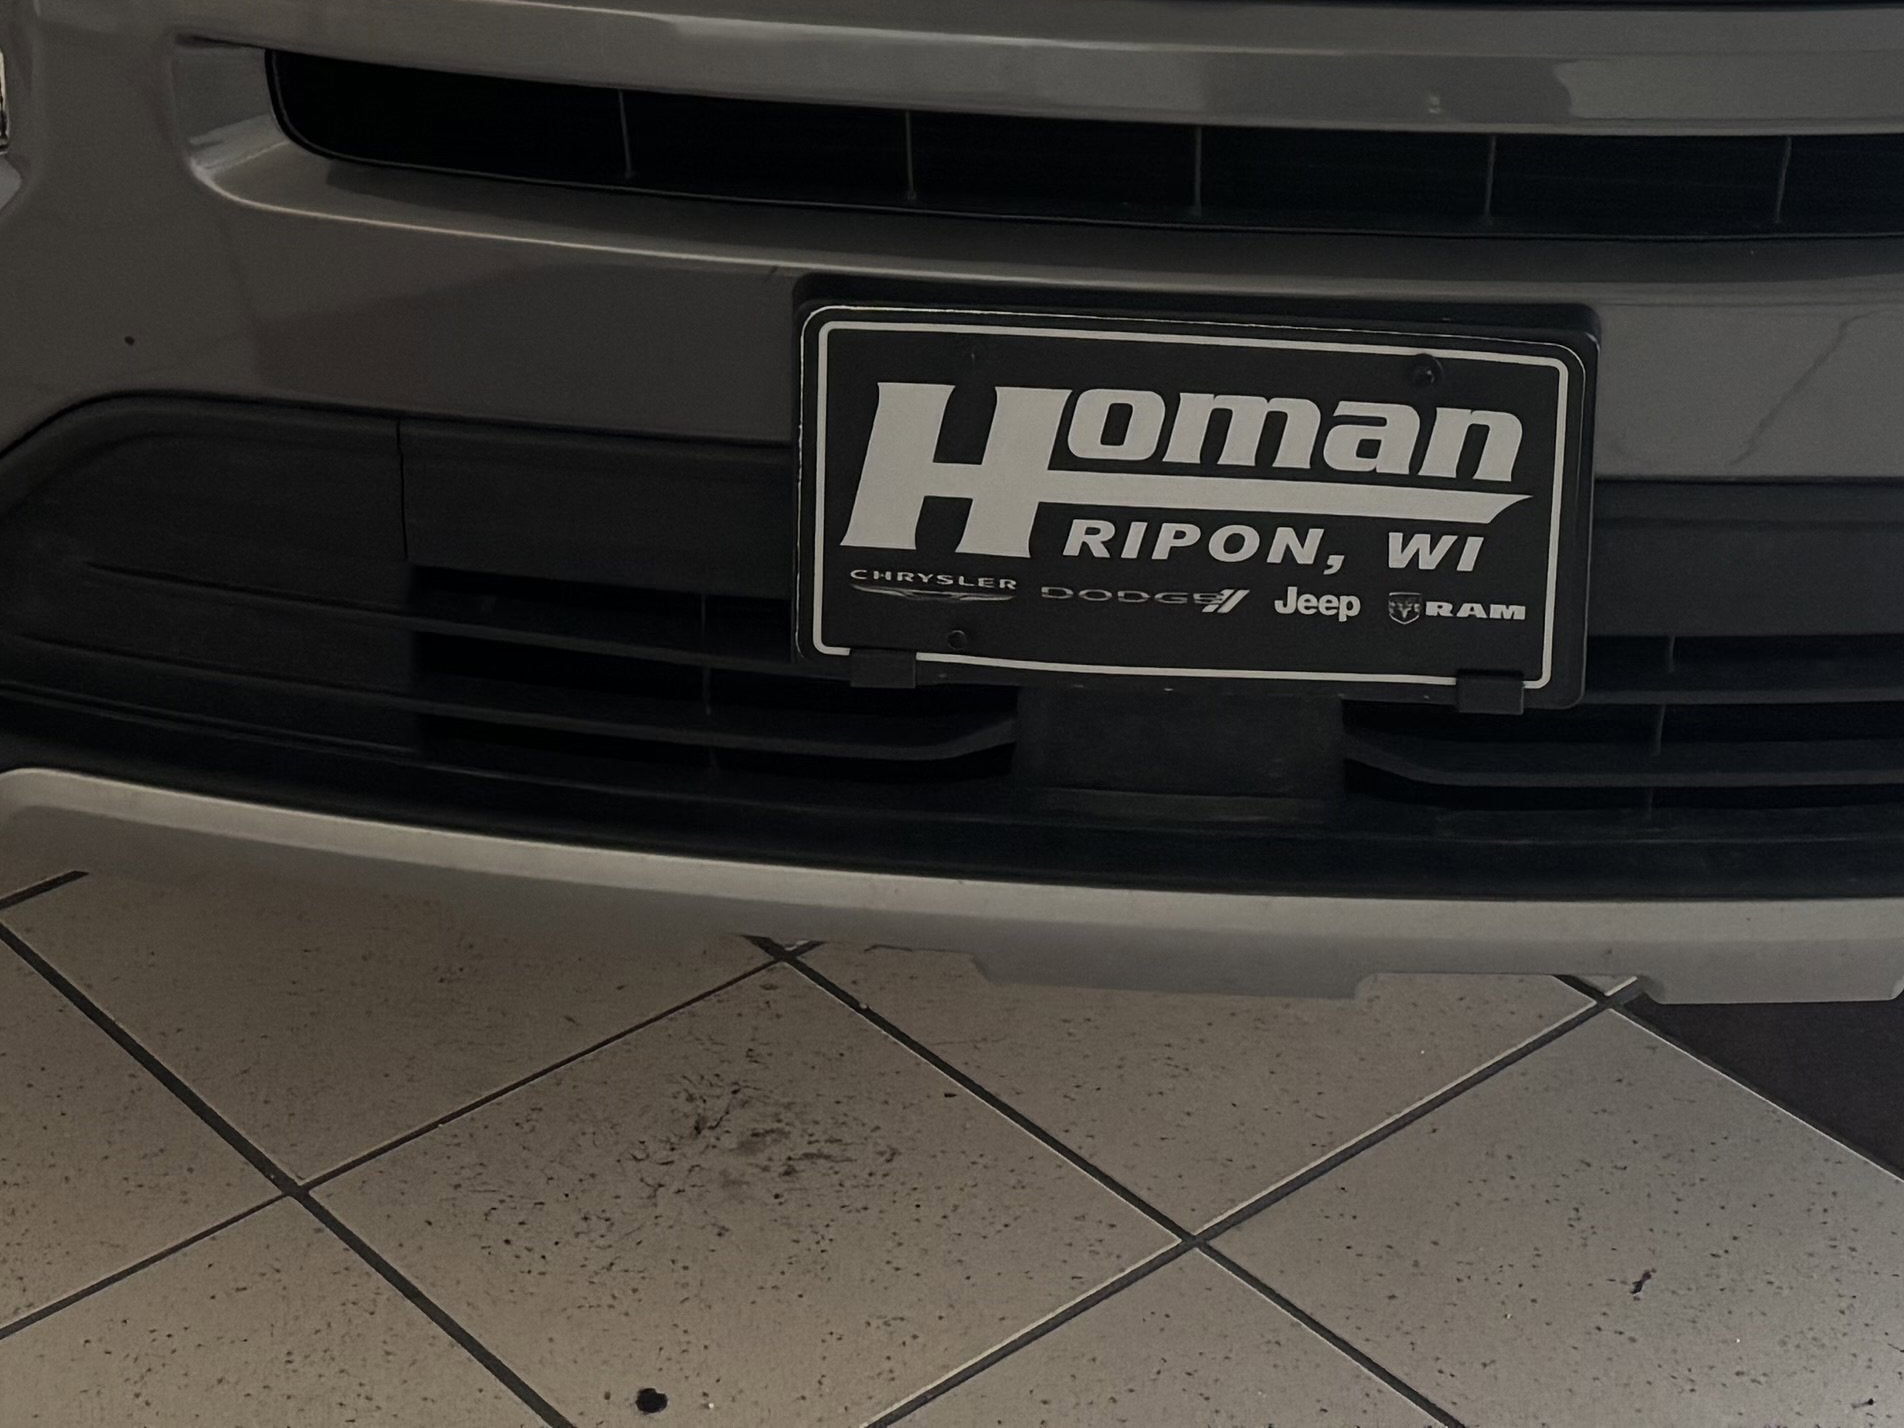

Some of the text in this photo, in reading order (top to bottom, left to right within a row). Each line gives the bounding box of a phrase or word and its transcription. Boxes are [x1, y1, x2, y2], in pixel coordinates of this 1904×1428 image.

[840, 381, 1524, 558] Homan
[1061, 519, 1485, 575] RIPON, WI
[849, 568, 1017, 591] CHRYSLER
[1040, 586, 1225, 605] DODGE
[1274, 585, 1362, 623] Jeep
[1425, 600, 1527, 621] RAM
